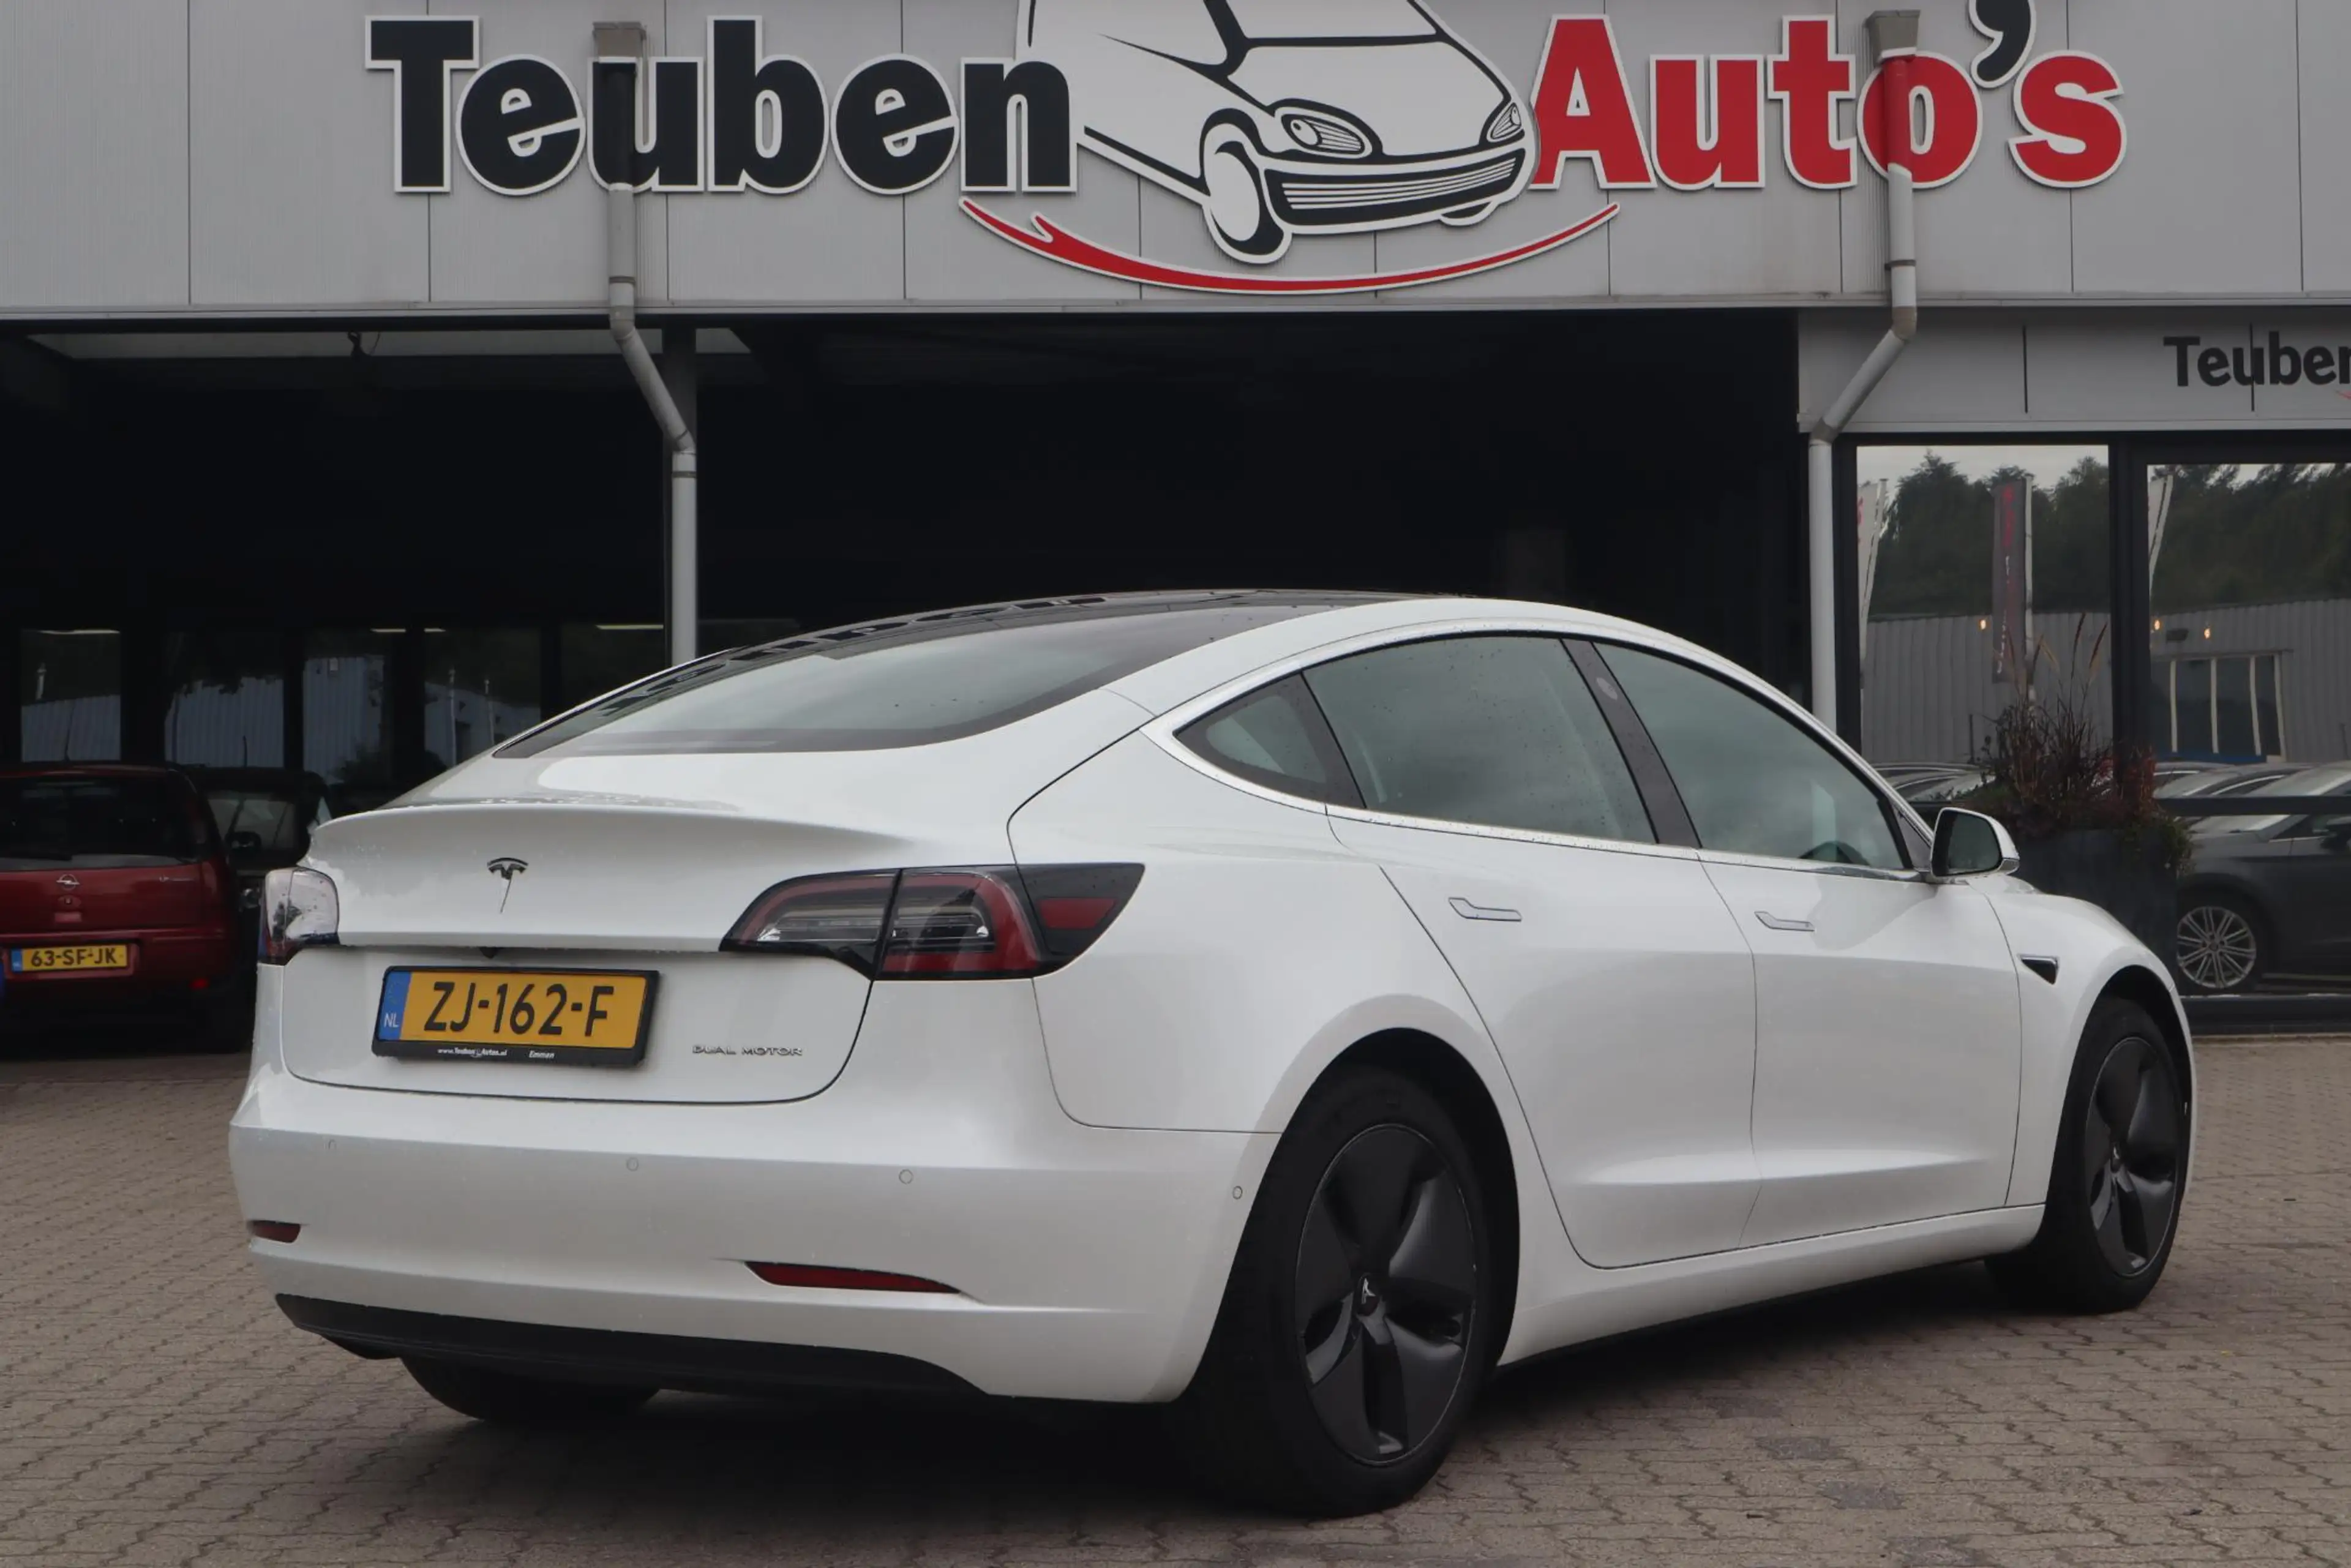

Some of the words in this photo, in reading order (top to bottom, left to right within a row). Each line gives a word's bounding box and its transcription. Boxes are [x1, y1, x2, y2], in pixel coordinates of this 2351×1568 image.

[366, 16, 1076, 194] Teuben
[1529, 0, 2127, 189] Auto's
[31, 948, 116, 967] 63-SF-JK
[424, 981, 615, 1037] ZJ-162-F
[384, 1012, 399, 1027] NL
[692, 1045, 737, 1055] DUAL
[741, 1046, 803, 1056] MOTOR
